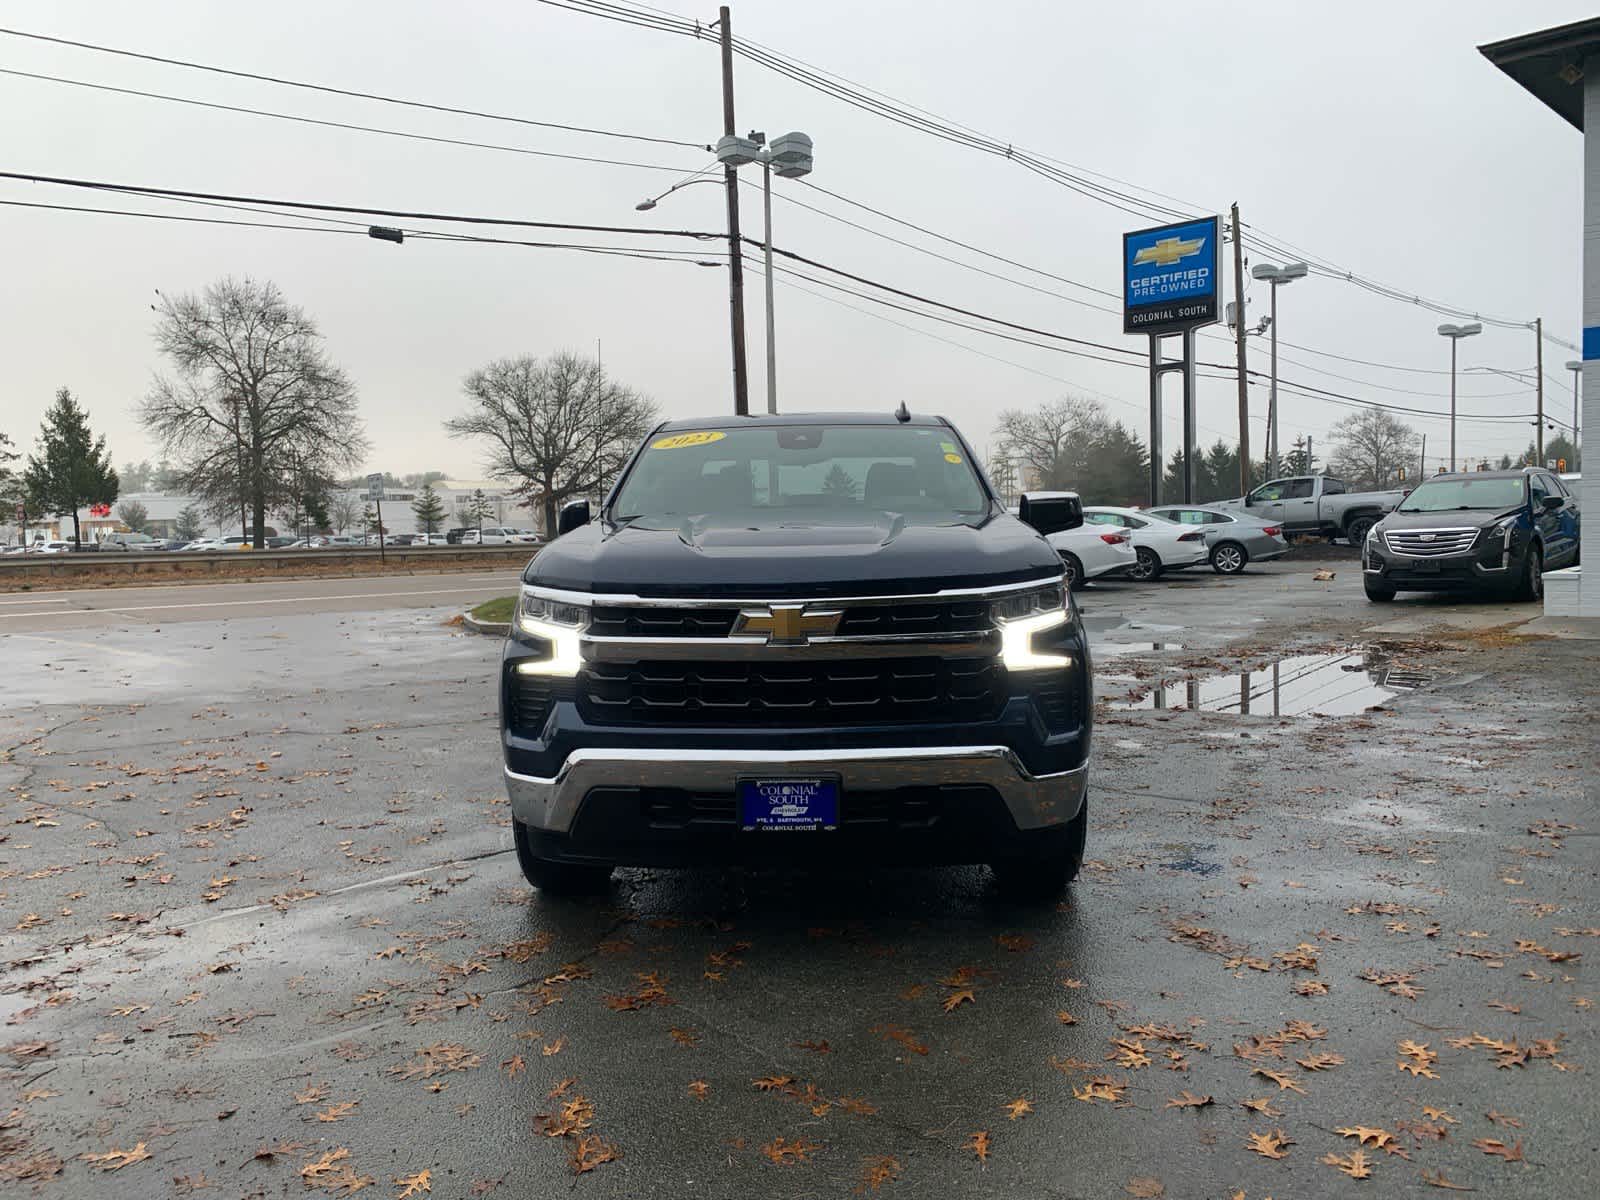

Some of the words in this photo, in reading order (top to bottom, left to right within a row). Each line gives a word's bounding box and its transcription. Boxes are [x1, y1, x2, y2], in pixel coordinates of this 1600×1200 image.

[1130, 267, 1209, 289] CERTIFIED
[1134, 278, 1206, 297] PRE-OWNED
[1132, 310, 1174, 324] COLONIAL
[1178, 305, 1208, 317] SOUTH
[759, 785, 818, 796] COLONIAL
[768, 795, 809, 805] SOUTH
